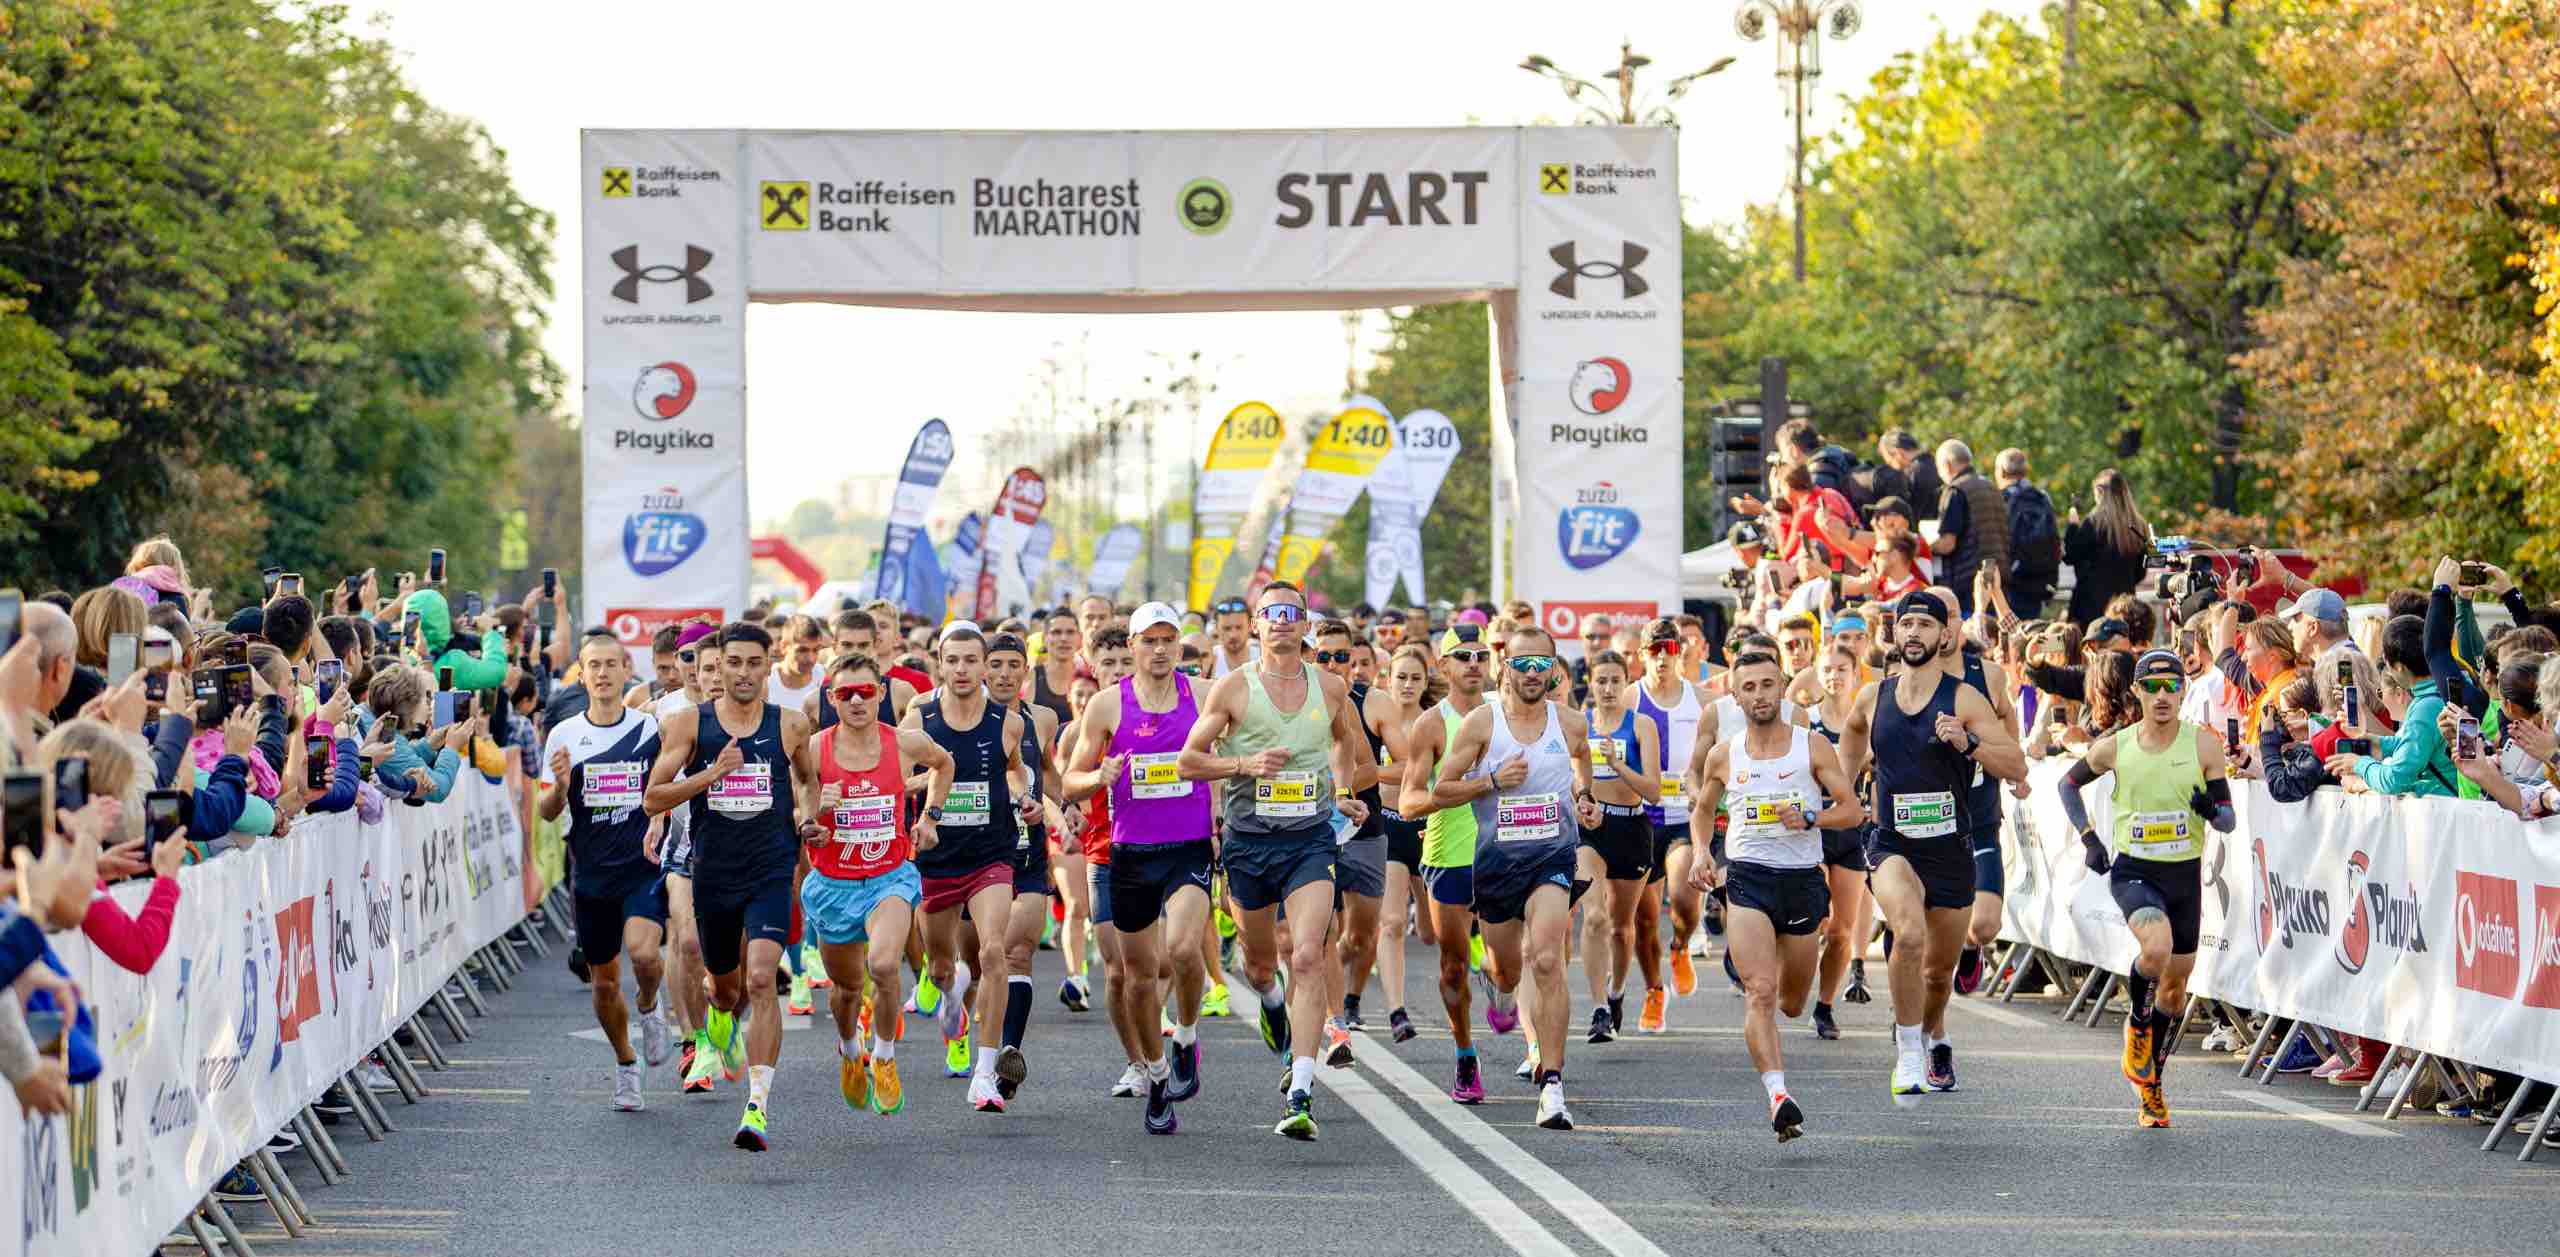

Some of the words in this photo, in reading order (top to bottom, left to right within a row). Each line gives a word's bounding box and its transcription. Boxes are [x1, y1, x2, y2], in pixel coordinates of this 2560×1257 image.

[637, 167, 720, 181] Raiffeisen
[1575, 164, 1657, 178] Raiffeisen
[637, 185, 681, 197] Bank
[818, 181, 956, 206] Raiffeisen
[973, 178, 1140, 208] Bucharest
[1276, 171, 1489, 229] START
[1575, 181, 1617, 194] Bank
[818, 209, 891, 233] Bank
[973, 210, 1141, 236] MARATHON
[602, 315, 654, 325] UNDER
[658, 315, 722, 325] ARMOUR
[1541, 310, 1591, 320] UNDER
[1594, 310, 1657, 320] ARMOUR
[1225, 415, 1280, 440] 1:40
[1330, 421, 1388, 448] 1:40
[1400, 426, 1453, 449] 1:30
[1551, 423, 1648, 448] Playtika
[615, 429, 715, 454] Playtika
[632, 515, 689, 563] fit
[1568, 510, 1625, 556] fit
